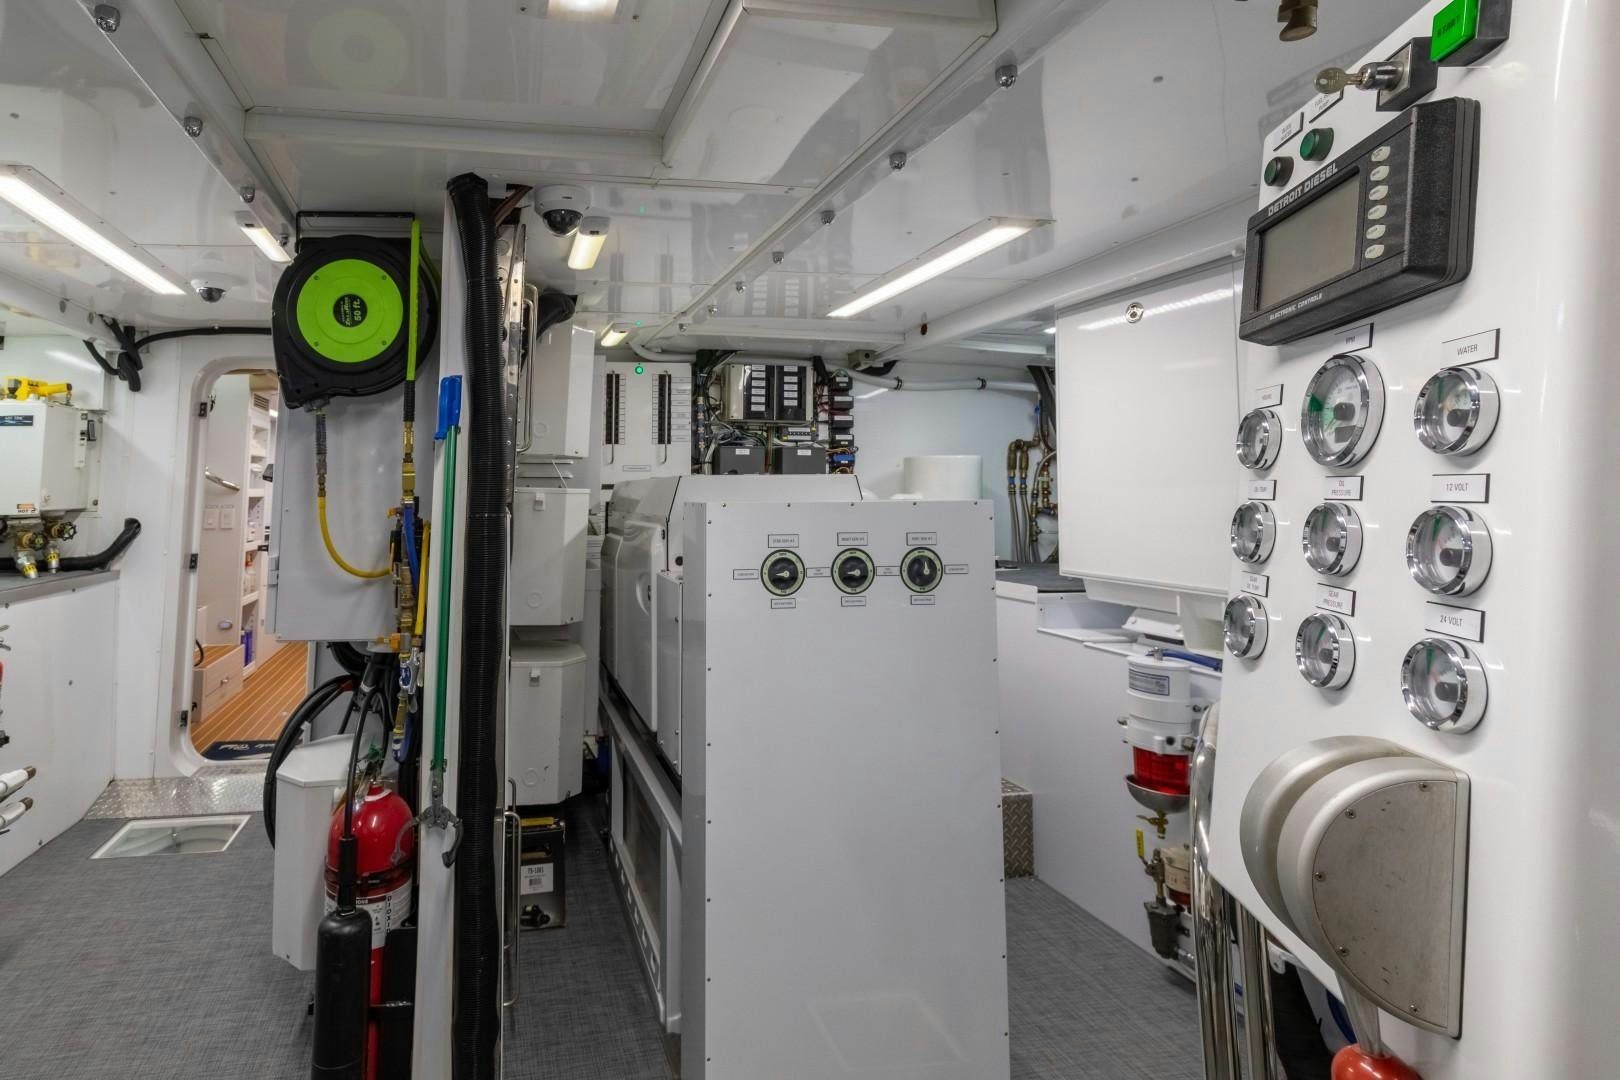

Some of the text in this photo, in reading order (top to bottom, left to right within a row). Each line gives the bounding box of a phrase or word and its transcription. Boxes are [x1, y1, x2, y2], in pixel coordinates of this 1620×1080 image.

[1267, 162, 1338, 216] DETROIT DIESEL
[353, 310, 361, 321] 50
[1269, 304, 1297, 321] ELECTRONIC
[1457, 344, 1478, 356] WATER
[1454, 482, 1469, 492] VOLT
[1448, 616, 1463, 628] VOLT
